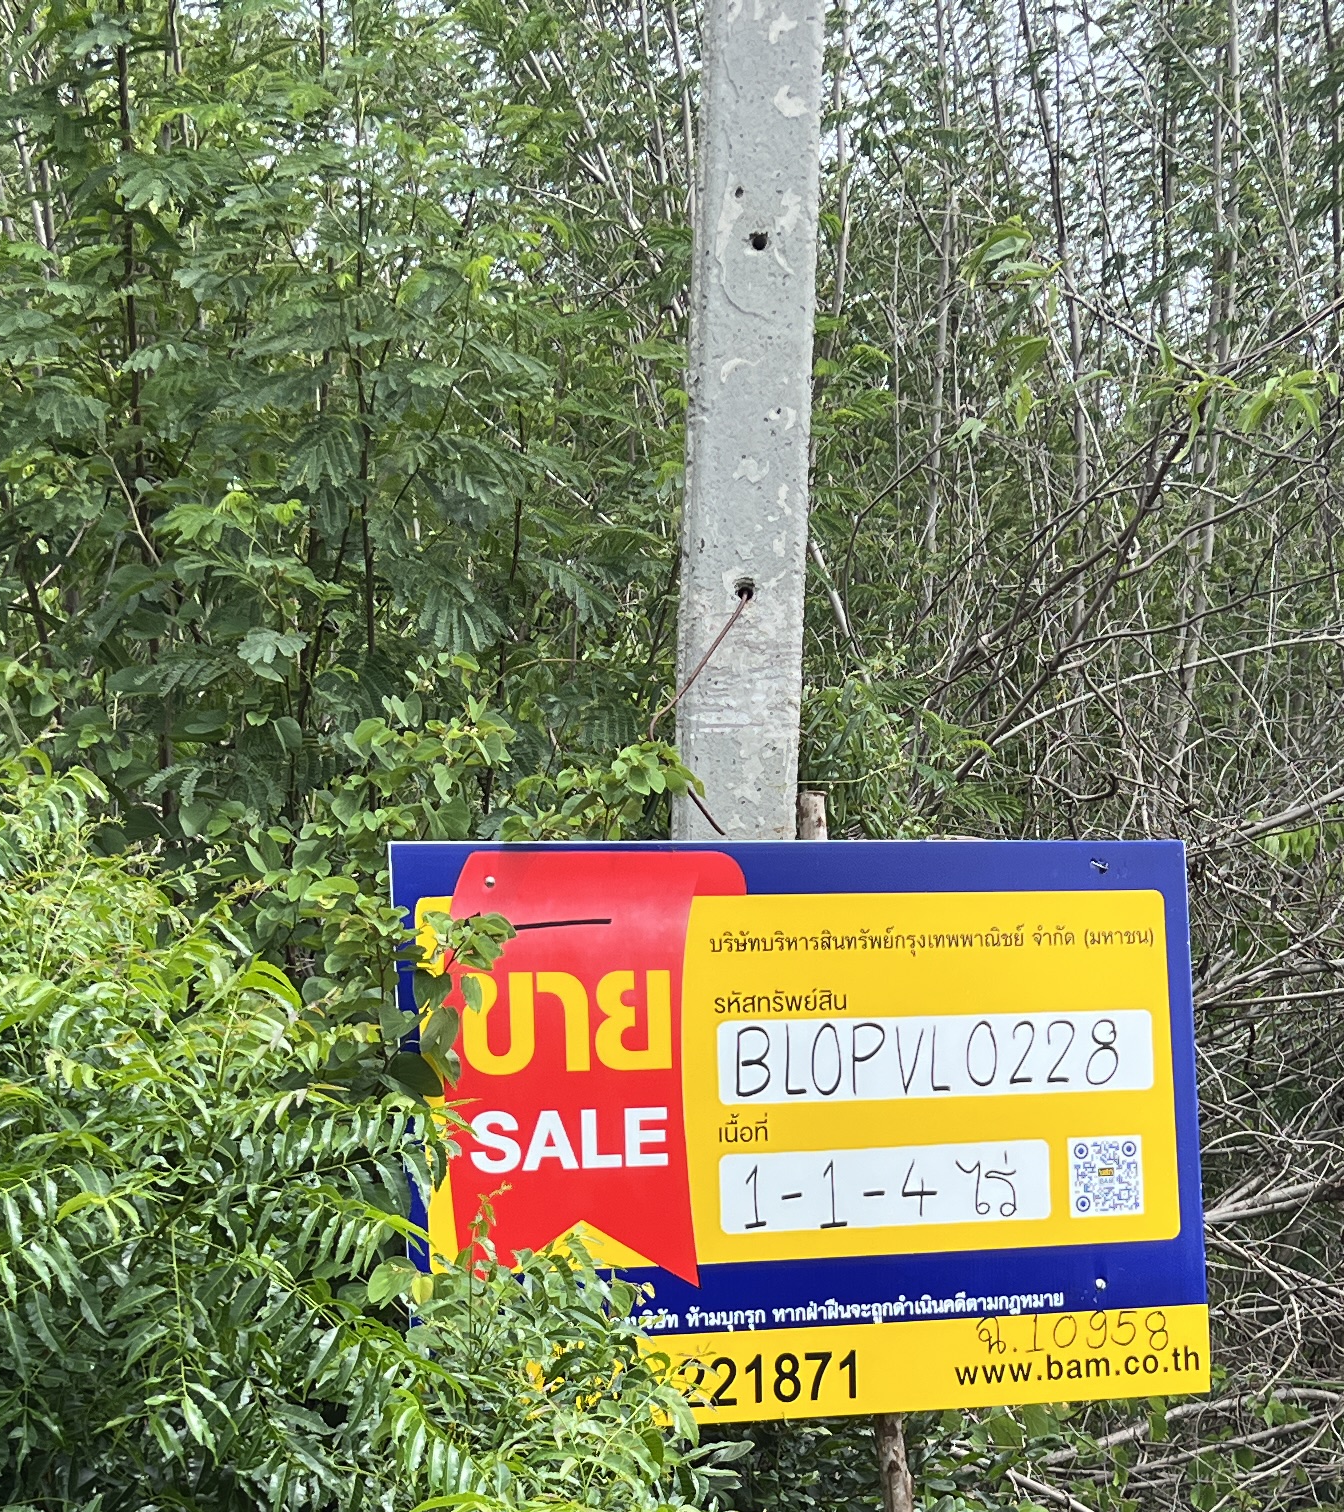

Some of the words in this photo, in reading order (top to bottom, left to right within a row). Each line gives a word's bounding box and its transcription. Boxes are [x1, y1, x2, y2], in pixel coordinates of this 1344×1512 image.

[709, 923, 1025, 958] บริษัทบริหารสินทรัพย์กรุงเทพพาณิชย์
[1031, 924, 1075, 947] จำกัด
[1083, 927, 1155, 950] (มหาชน)
[713, 987, 848, 1014] รหัสทรัพย์สิน
[460, 969, 673, 1076] ขาย
[469, 1106, 670, 1175] SALE
[718, 1112, 769, 1143] เนื้อที่
[685, 1306, 766, 1332] ห้ามบุกรุก
[954, 1345, 1201, 1386] www.bam.co.th
